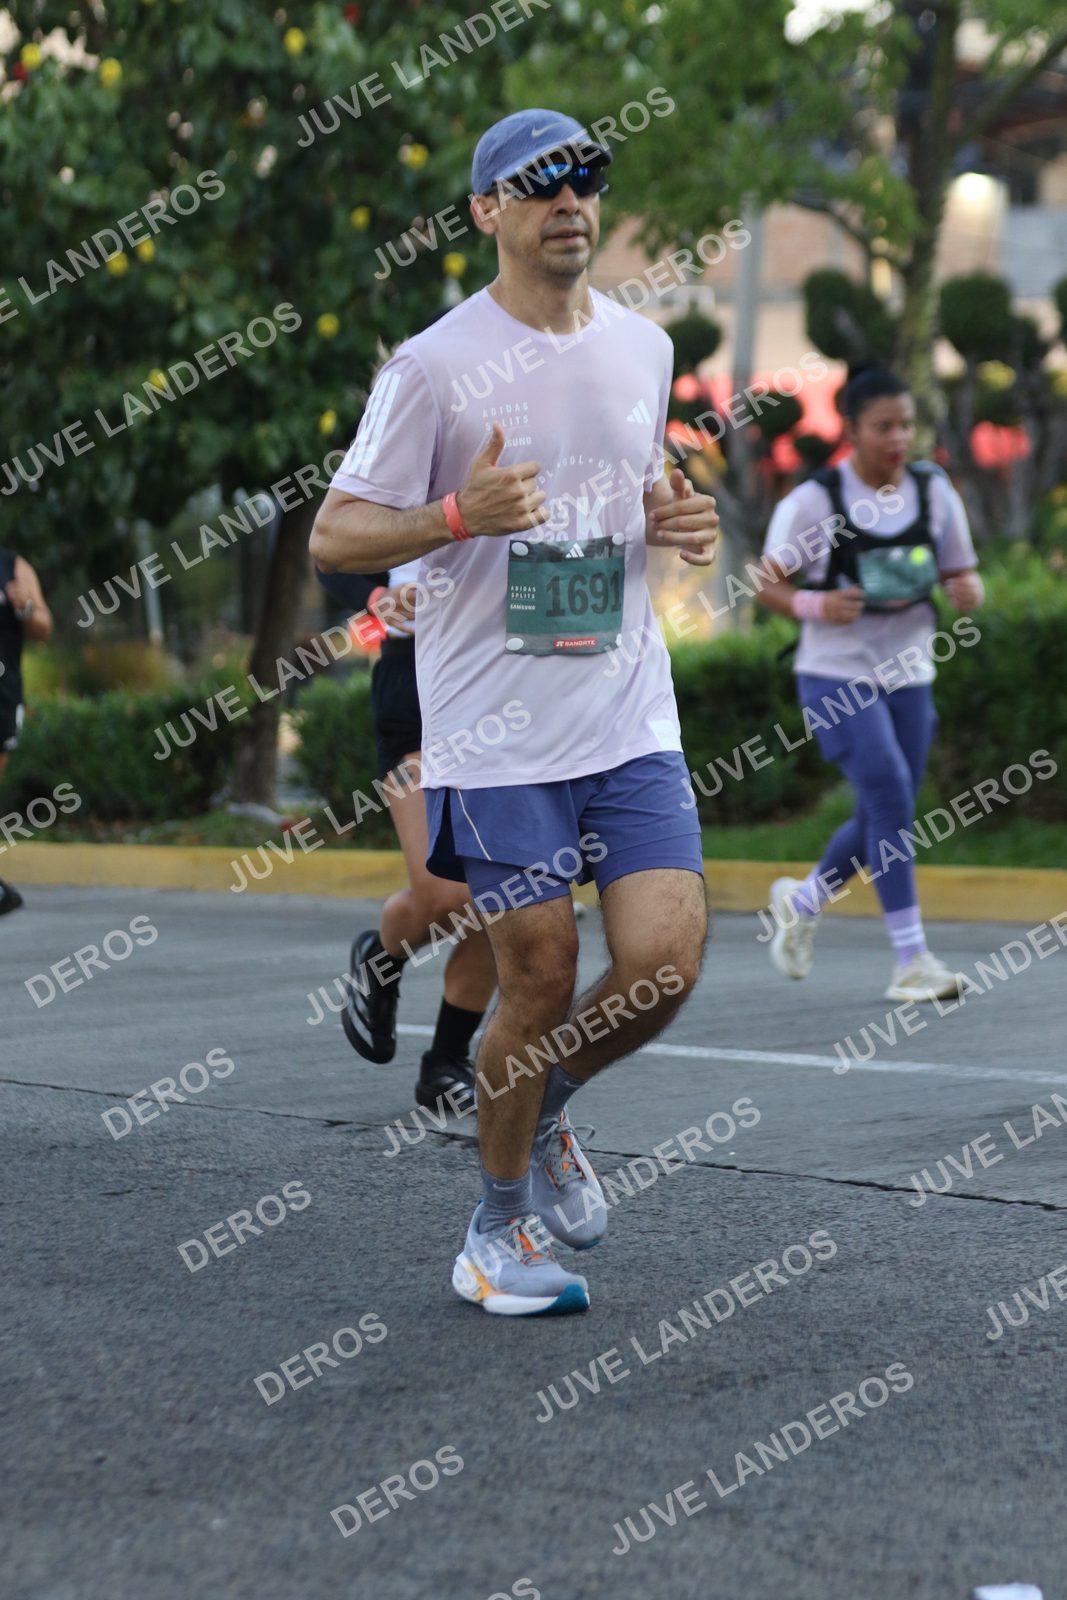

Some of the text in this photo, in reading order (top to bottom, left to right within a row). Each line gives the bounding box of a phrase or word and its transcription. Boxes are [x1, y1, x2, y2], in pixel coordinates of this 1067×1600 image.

[482, 402, 529, 417] ADIDAS
[485, 414, 529, 432] SLITS
[545, 571, 621, 617] 1691
